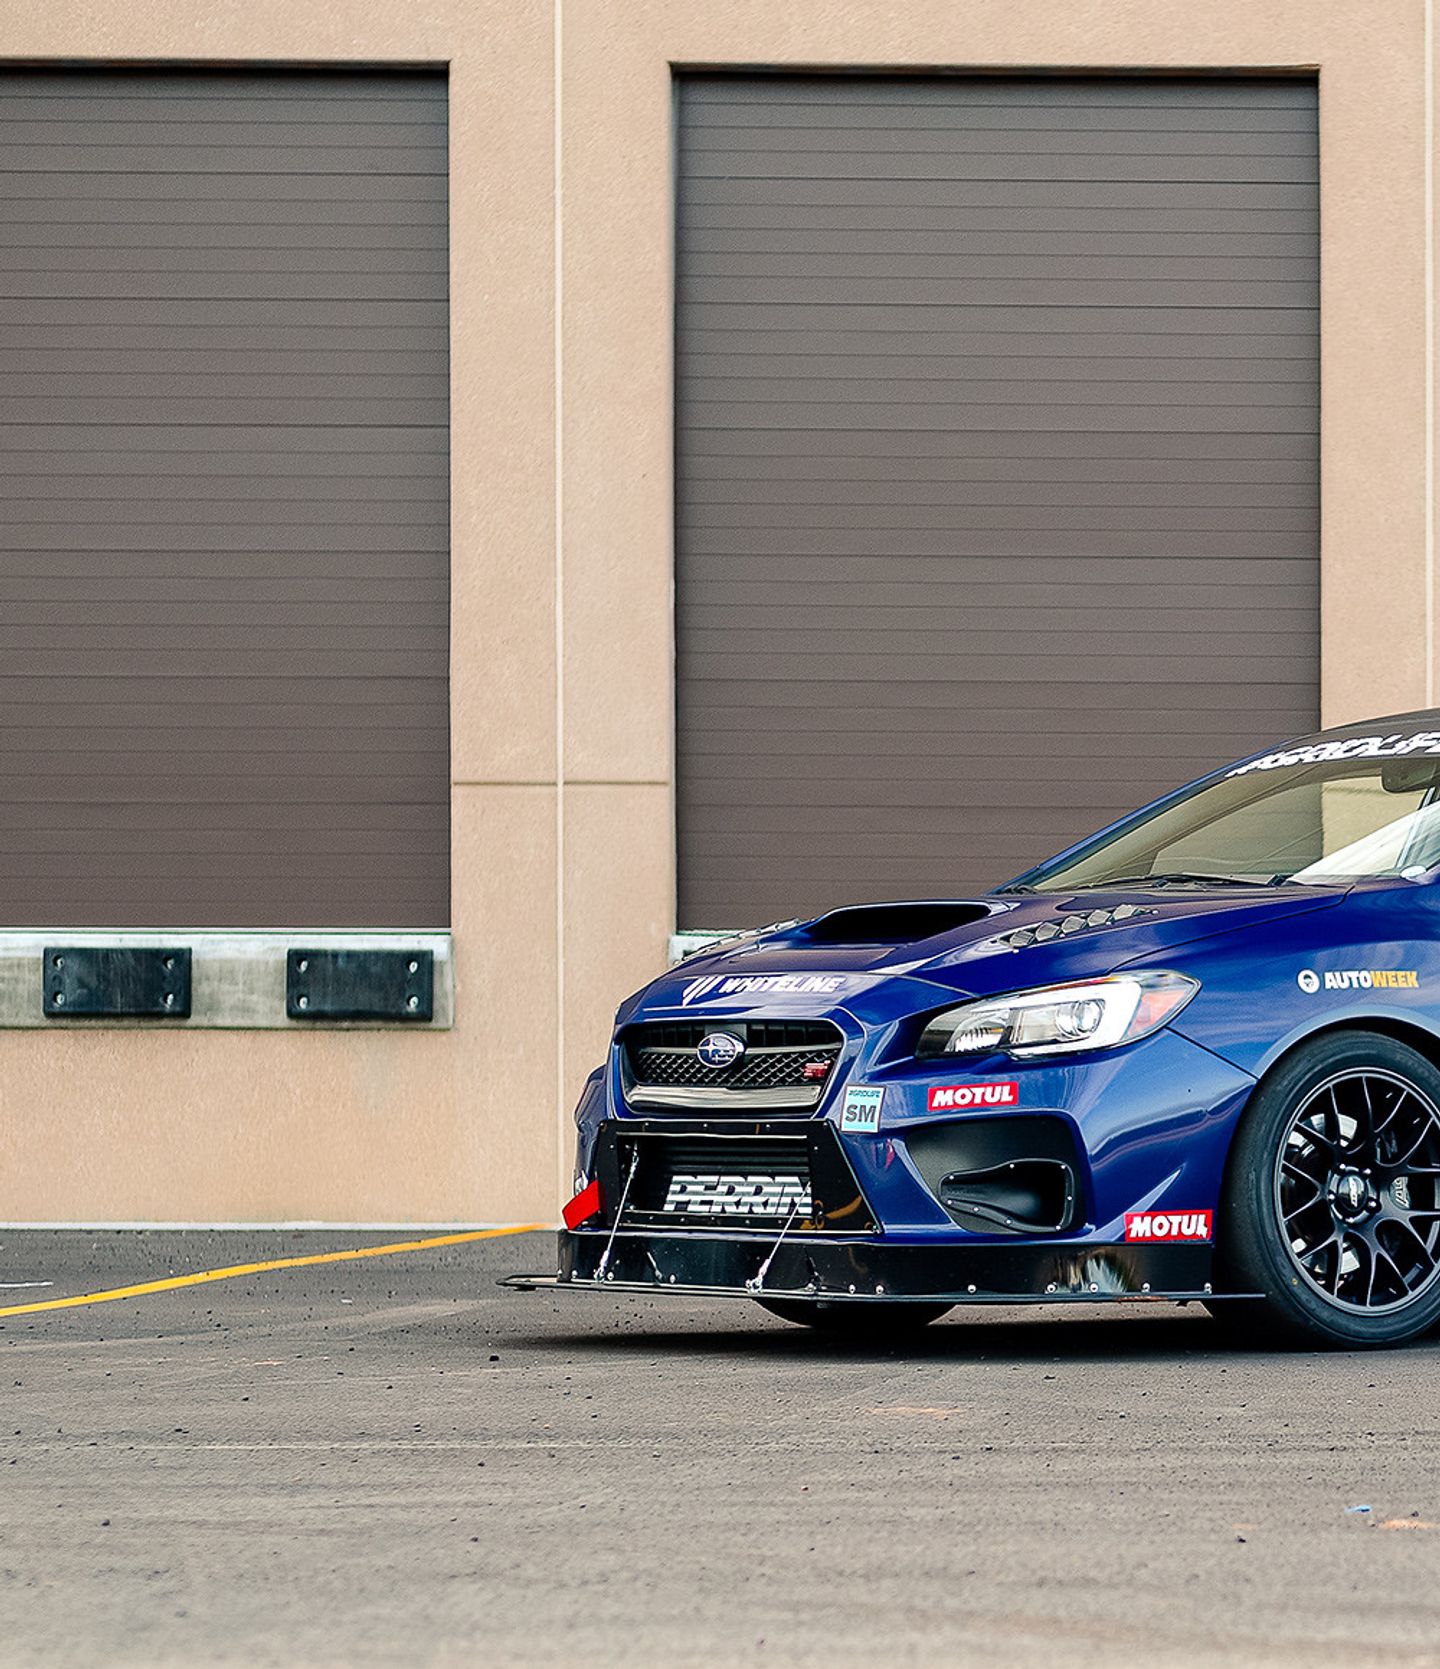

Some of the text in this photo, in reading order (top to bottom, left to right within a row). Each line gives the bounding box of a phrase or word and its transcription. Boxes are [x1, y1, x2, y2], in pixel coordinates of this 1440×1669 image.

[719, 976, 847, 994] WHITELINE
[932, 1085, 1014, 1107] MOTUL
[845, 1104, 877, 1123] SM
[663, 1175, 813, 1215] PERRIN
[1128, 1214, 1209, 1239] MOTUL
